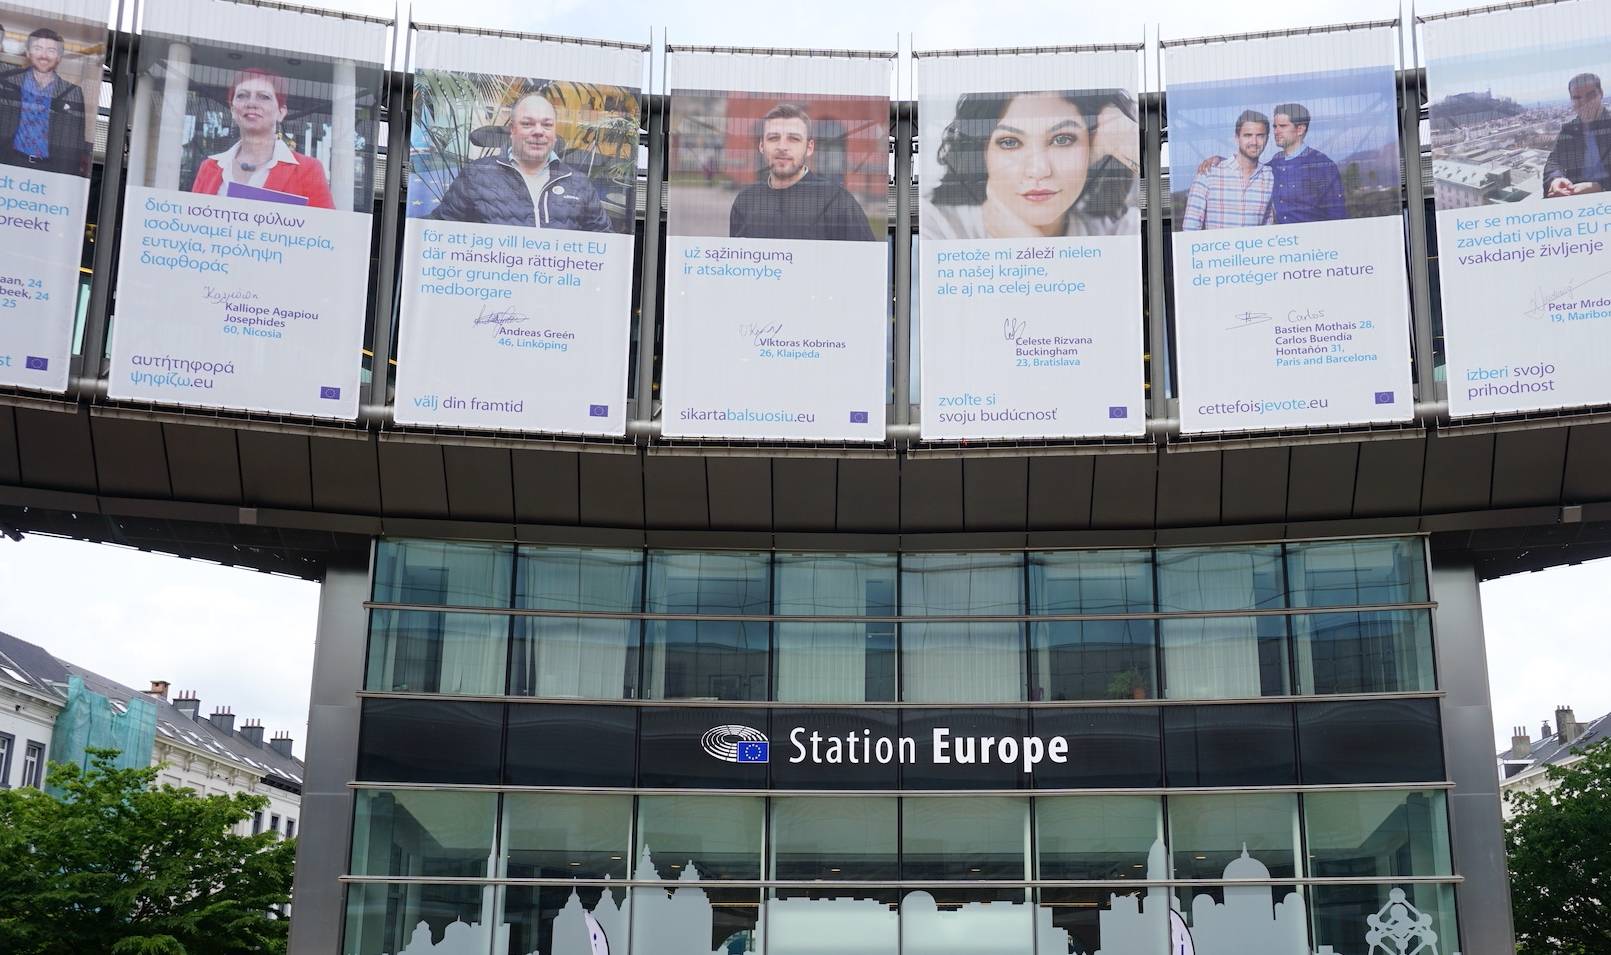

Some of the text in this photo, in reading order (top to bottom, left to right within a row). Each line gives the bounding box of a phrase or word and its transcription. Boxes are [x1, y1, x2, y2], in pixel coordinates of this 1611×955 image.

[19, 179, 47, 195] dat
[145, 197, 305, 228] διότι ισότητα φύλων
[1456, 218, 1481, 232] ker
[1484, 217, 1501, 229] se
[1506, 208, 1573, 226] moramo
[144, 218, 334, 251] ισοδυναμεί με ευημερία,
[423, 229, 607, 256] för att jag vill leva i ett EU
[1456, 231, 1521, 248] zavedati
[1526, 226, 1572, 243] vpliva
[1577, 221, 1598, 236] EU
[142, 236, 282, 264] ευτυχία, πρόληψη
[684, 247, 793, 264] už sąžiningumą
[937, 245, 1102, 264] pretože mi záleží nielen
[1191, 240, 1231, 255] parce
[1234, 239, 1263, 252] que
[1458, 239, 1603, 265] vsakdanje življenje
[140, 250, 229, 274] διαφθοράς
[422, 247, 604, 271] där mänskliga rättigheter
[1192, 248, 1338, 270] la meilleure manière
[422, 265, 581, 287] utgör grunden för alla
[684, 262, 782, 280] ir atsakomybę
[937, 264, 1048, 280] na našej krajine,
[1192, 265, 1373, 288] de protéger notre nature
[28, 279, 42, 288] 24
[421, 283, 512, 300] medborgare
[937, 280, 1086, 297] ale aj na celej európe
[35, 291, 49, 301] 24
[225, 302, 319, 320] Kalliope Agapiou
[1549, 302, 1577, 312] Petar
[224, 314, 285, 327] Josephides
[1551, 314, 1564, 323] 19,
[224, 325, 281, 338] 60, Nicosia
[499, 327, 542, 337] Andreas
[1275, 325, 1312, 334] Bastien
[1315, 322, 1357, 332] Mothais
[497, 337, 567, 352] 46, Linköping
[760, 338, 846, 349] Viktoras Kobrinas
[1016, 335, 1092, 345] Celeste Rizvana
[1275, 336, 1307, 345] Carlos
[760, 349, 774, 358] 26,
[1016, 347, 1078, 357] Buckingham
[1276, 353, 1377, 367] Paris and Barcelona
[131, 355, 234, 375] αυτήτηφορά
[1016, 358, 1080, 367] 23, Bratislava
[131, 371, 213, 389] ψηφίζω.eu
[1467, 362, 1555, 381] izberi svojo
[1468, 380, 1555, 400] prihodnost
[414, 395, 523, 413] välj din framtid
[985, 395, 997, 405] si
[1198, 399, 1328, 415] cettefoisjevote.eu
[680, 408, 815, 423] sikartabalsuosiu.eu
[939, 410, 976, 425] svoju
[789, 727, 1069, 772] Station Europe
